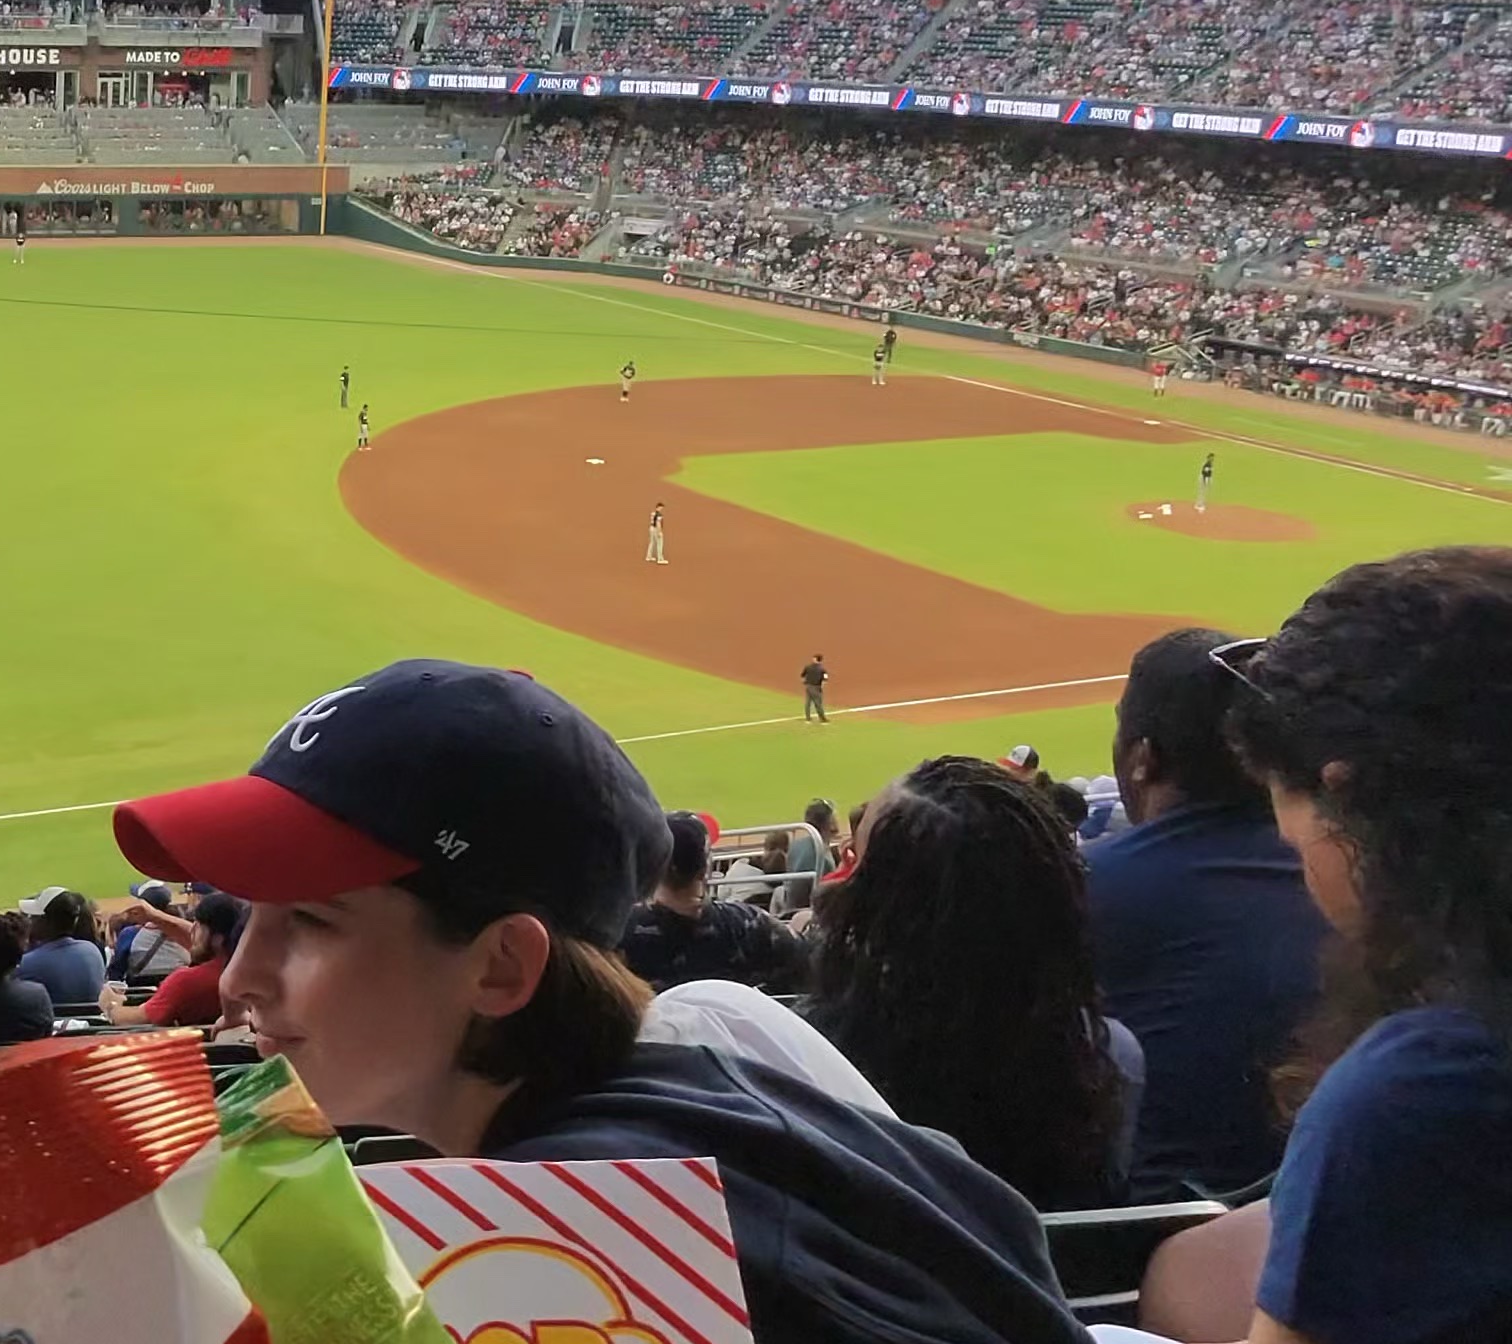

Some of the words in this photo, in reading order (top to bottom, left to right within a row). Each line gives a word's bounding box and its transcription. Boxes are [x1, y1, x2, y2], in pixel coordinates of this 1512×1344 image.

[126, 51, 159, 64] MADE
[161, 51, 181, 64] TO
[350, 71, 368, 83] JOHN
[728, 84, 748, 97] JOHN
[53, 179, 90, 194] Coors
[92, 183, 126, 194] LIGHT
[130, 182, 169, 194] BELOW
[183, 182, 215, 194] CHOP
